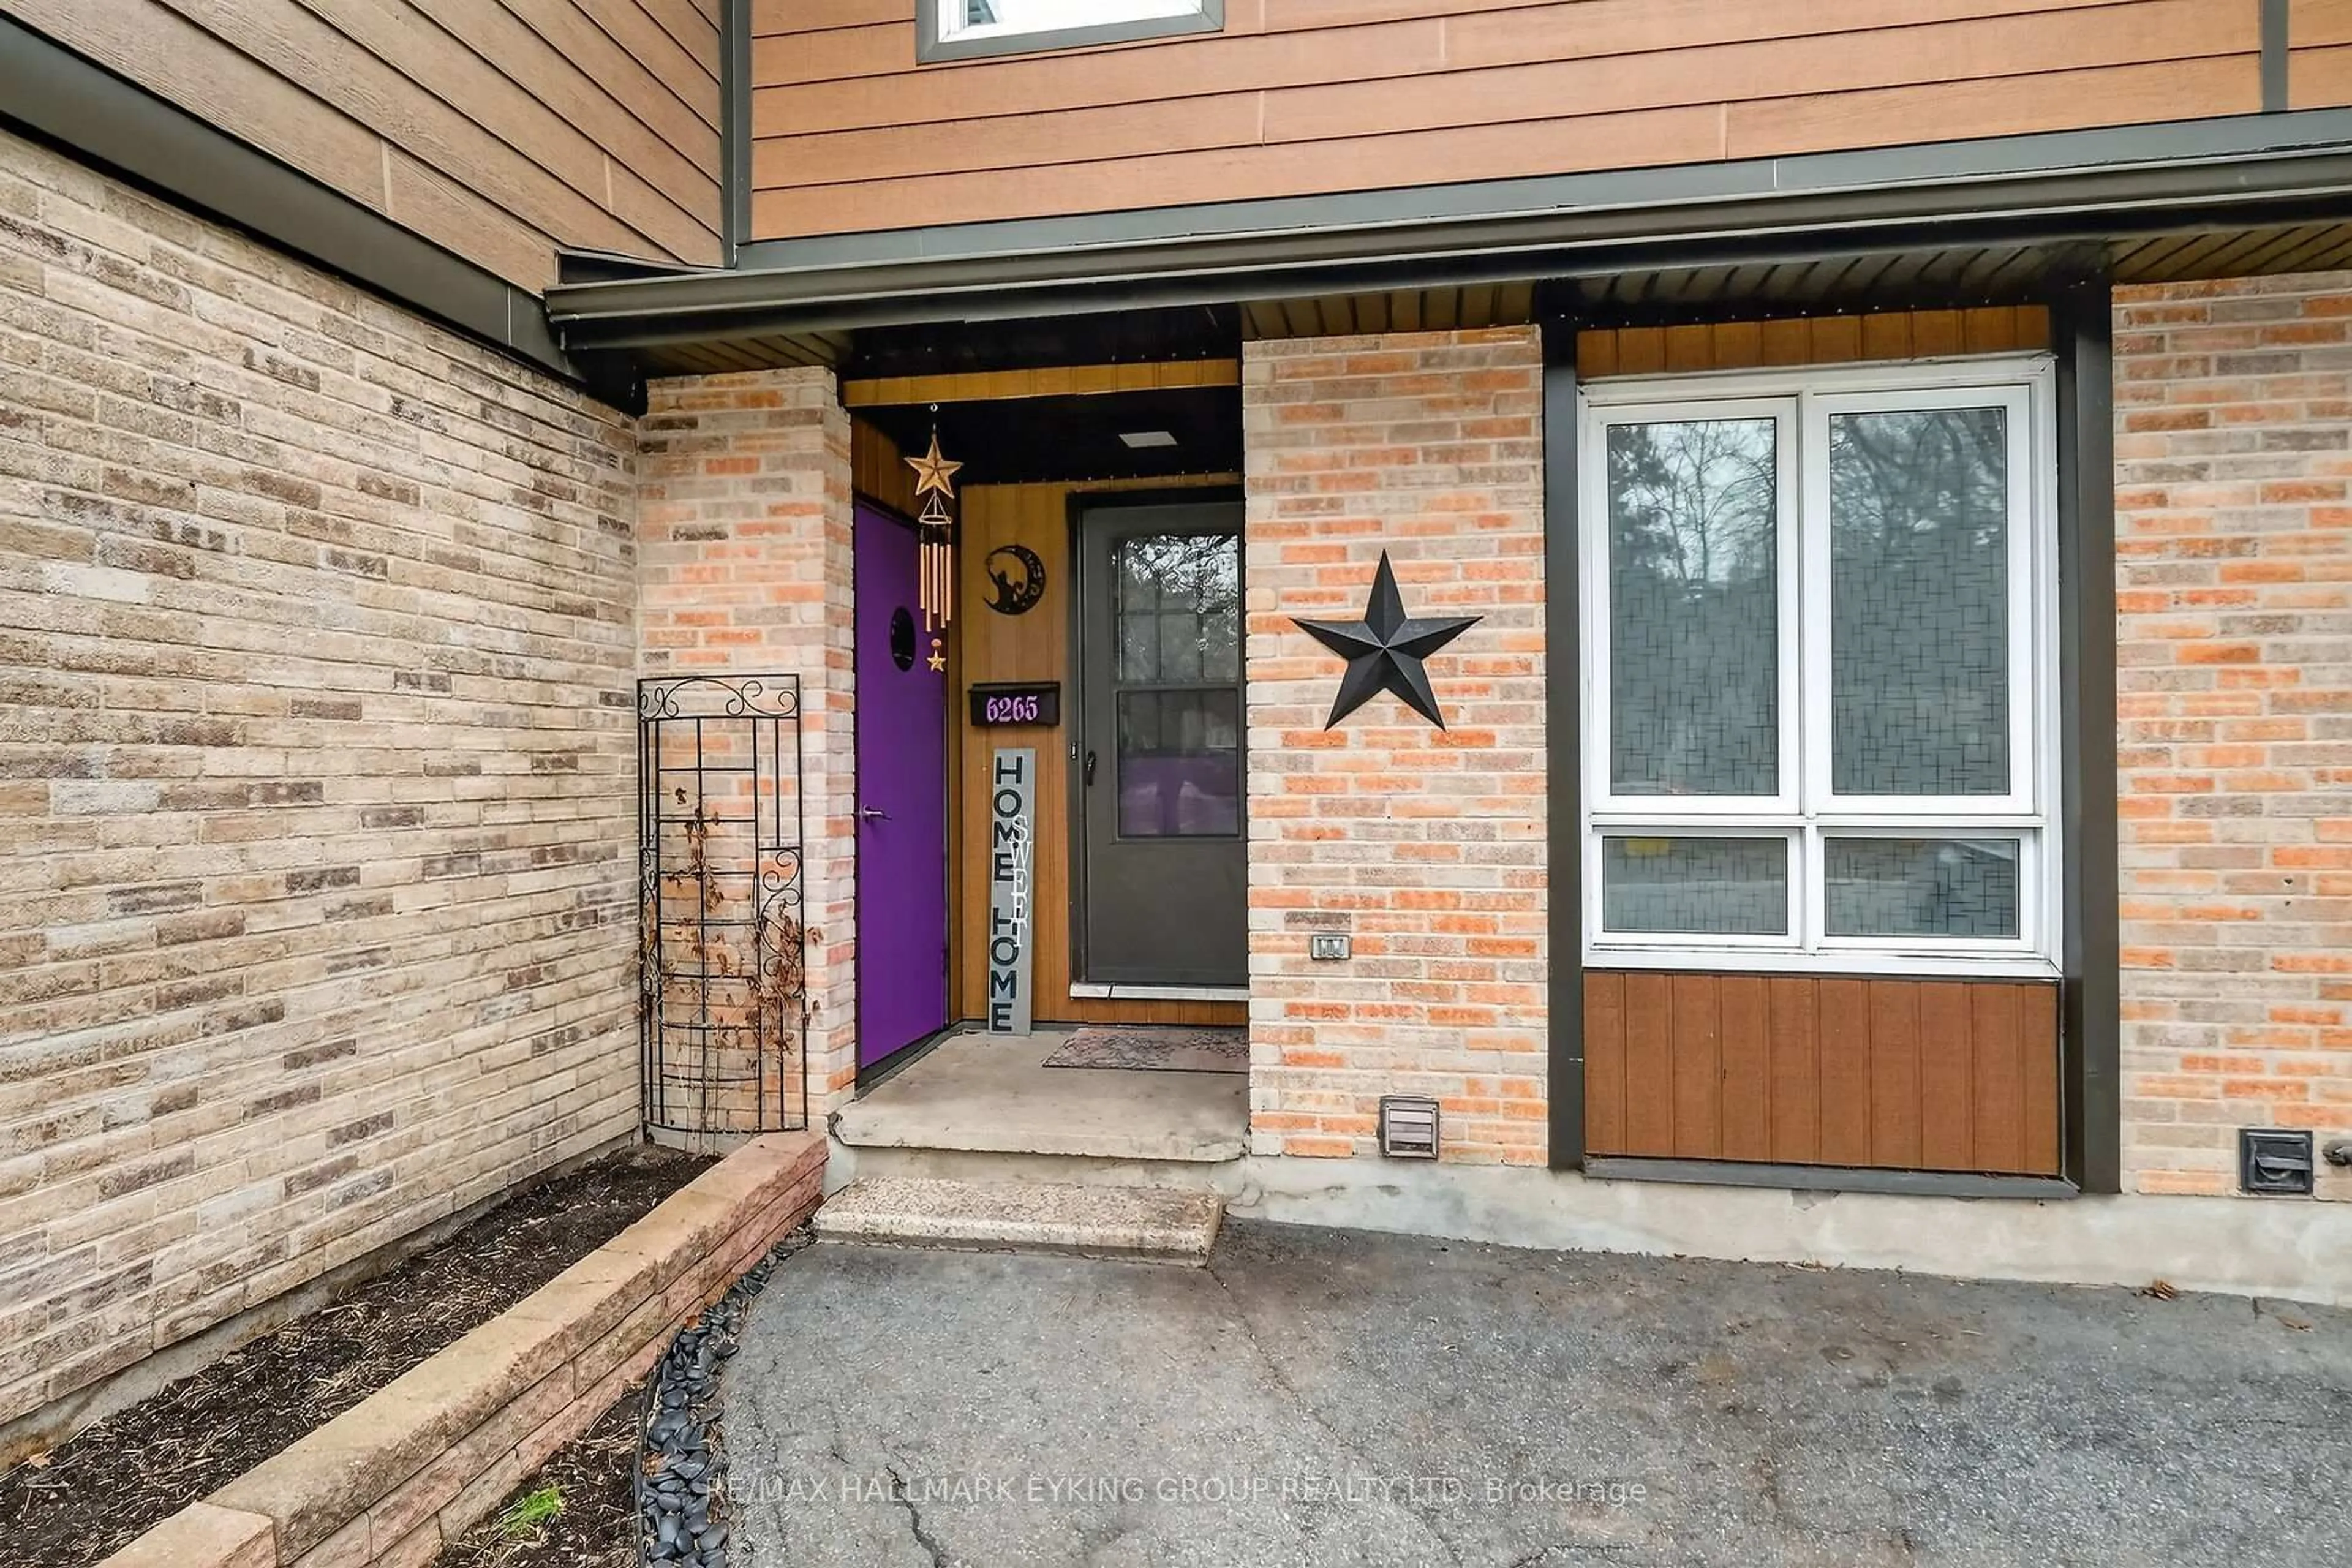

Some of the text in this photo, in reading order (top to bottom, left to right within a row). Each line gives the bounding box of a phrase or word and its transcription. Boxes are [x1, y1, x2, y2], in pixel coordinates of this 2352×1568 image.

[987, 696, 1038, 722] 6265
[990, 756, 1033, 1032] HOME SWEET HOME
